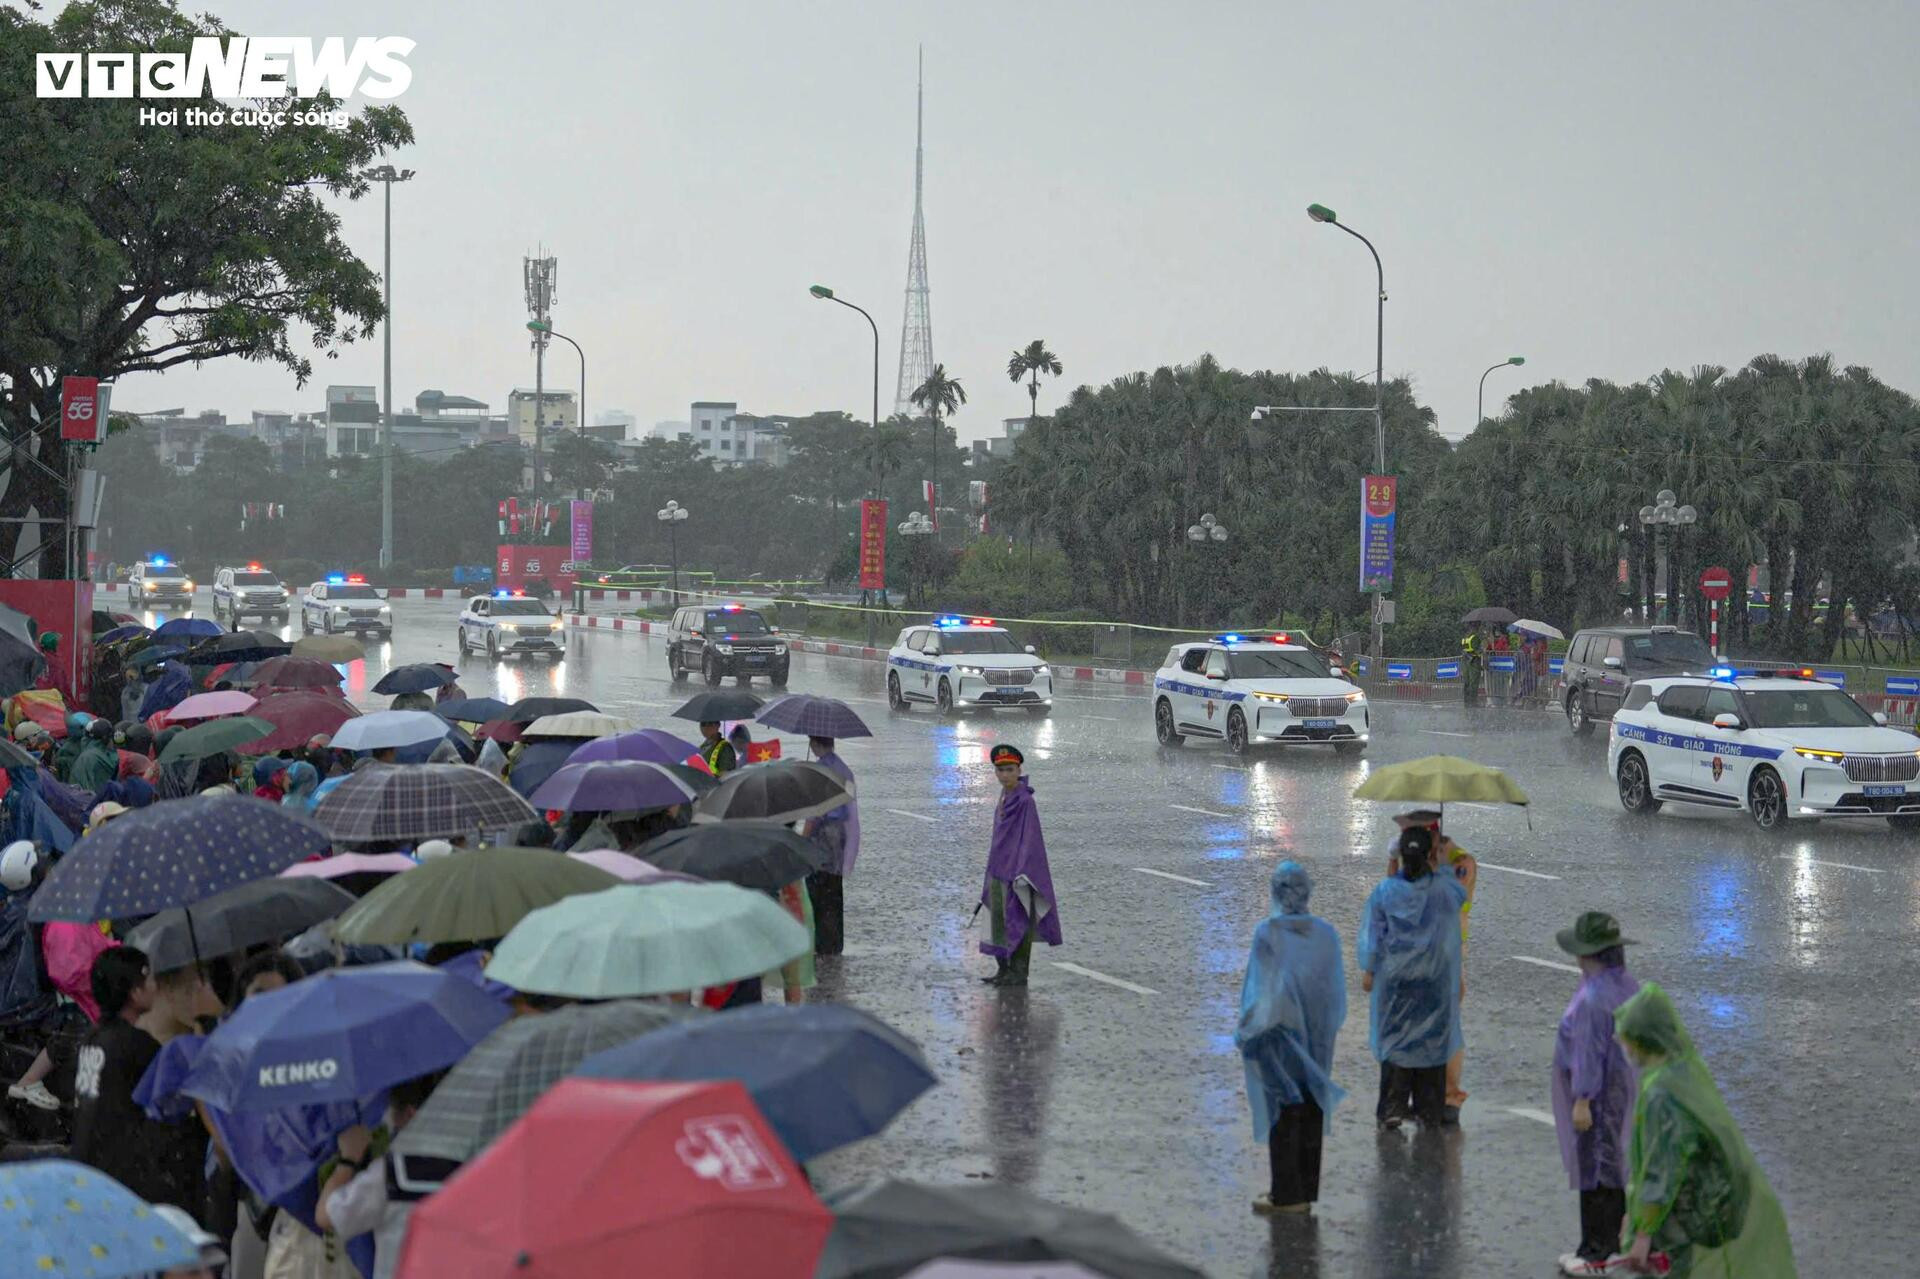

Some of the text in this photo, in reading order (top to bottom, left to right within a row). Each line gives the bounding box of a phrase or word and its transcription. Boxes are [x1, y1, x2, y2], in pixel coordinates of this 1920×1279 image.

[67, 402, 93, 420] 5G
[526, 561, 540, 573] 5G
[560, 561, 574, 573] 5G
[1656, 734, 1674, 746] SÁT
[1683, 739, 1705, 751] GIAO
[1712, 741, 1742, 756] THÔNG
[259, 1058, 337, 1087] KENKO
